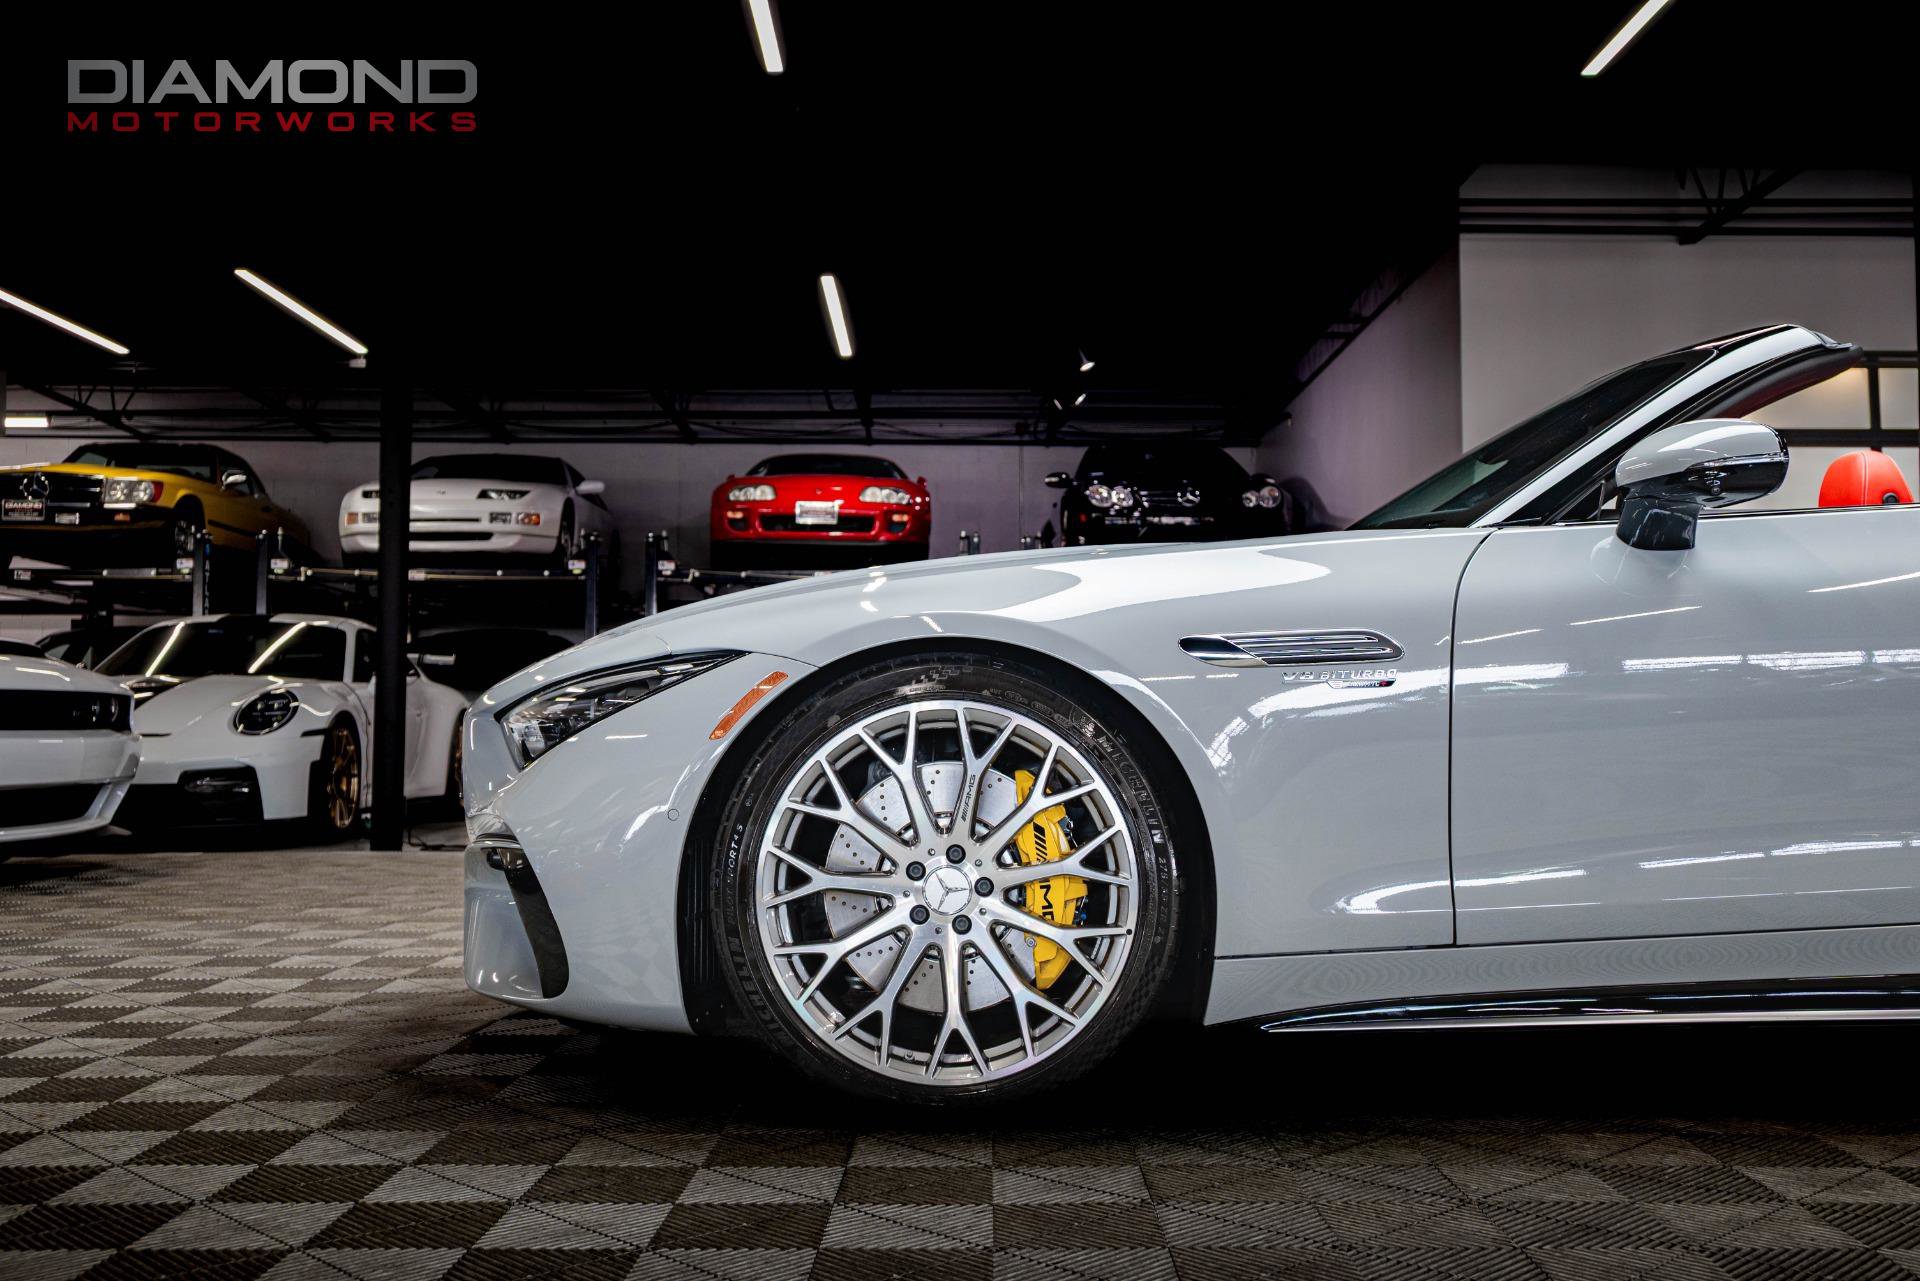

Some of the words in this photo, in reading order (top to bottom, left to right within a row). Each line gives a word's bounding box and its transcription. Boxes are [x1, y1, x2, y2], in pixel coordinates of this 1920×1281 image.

[1282, 671, 1315, 680] V8
[1320, 668, 1398, 680] BITURBO
[1096, 735, 1166, 844] MICHELIN
